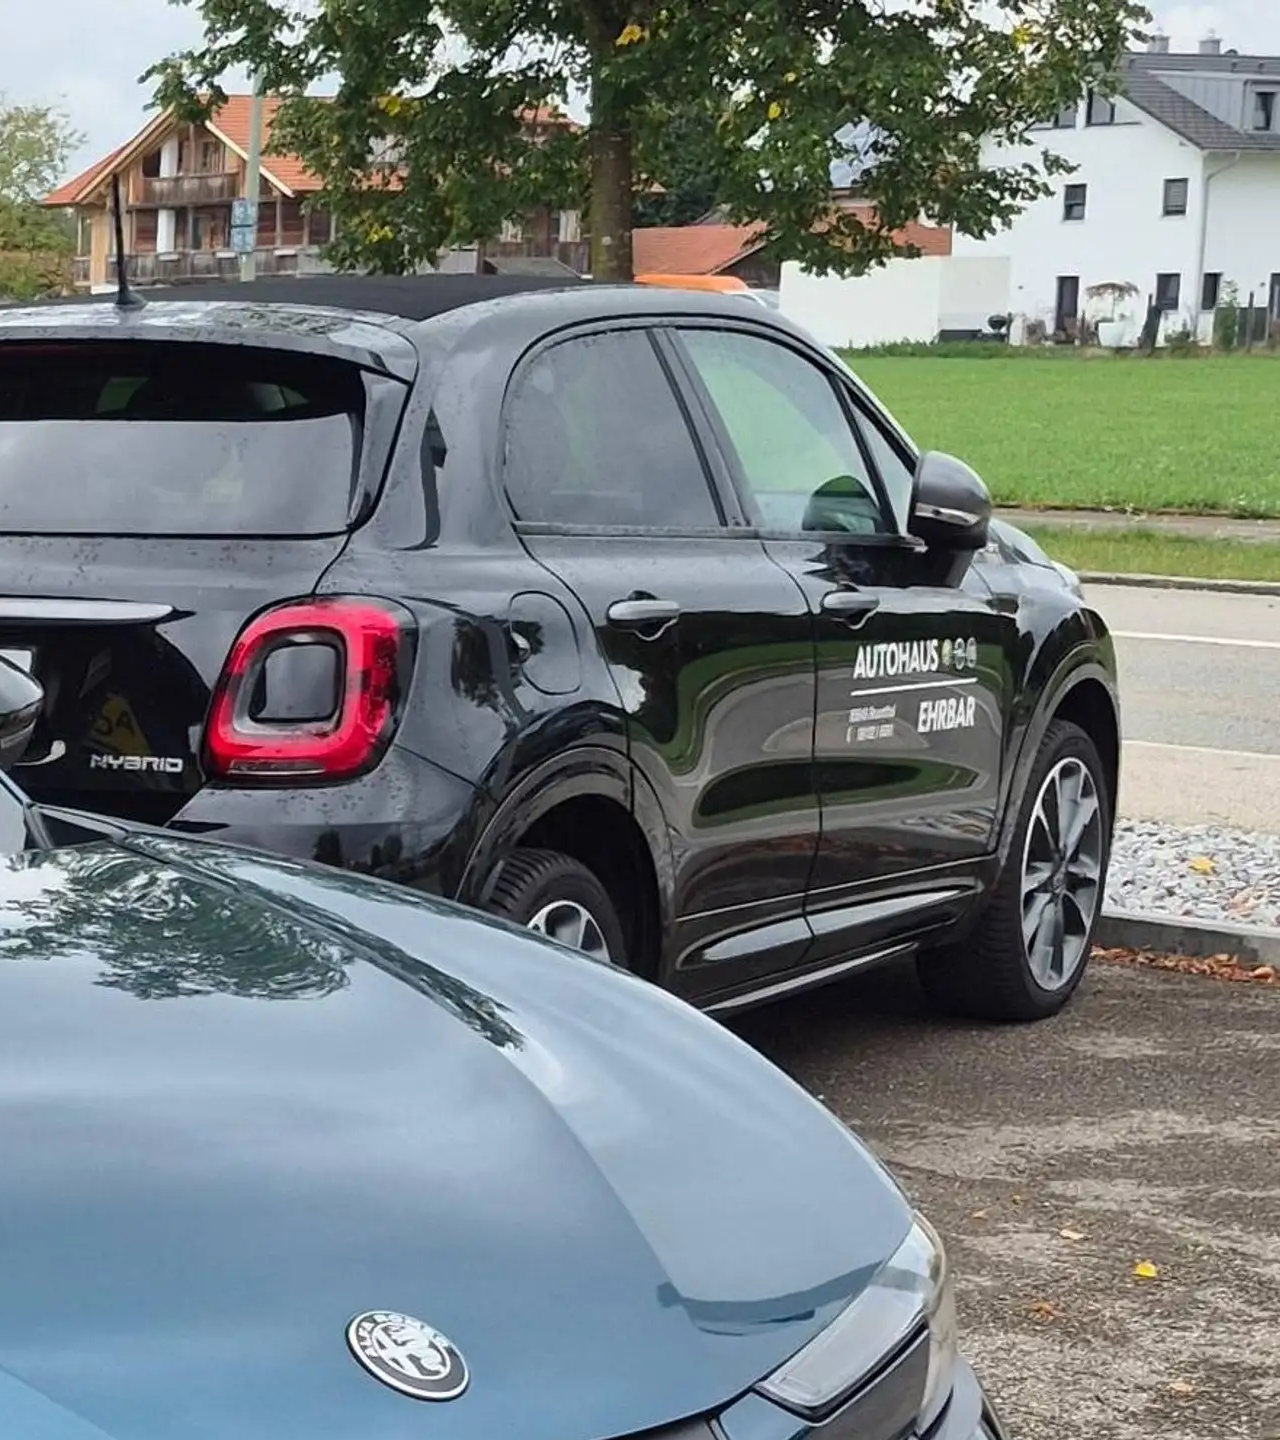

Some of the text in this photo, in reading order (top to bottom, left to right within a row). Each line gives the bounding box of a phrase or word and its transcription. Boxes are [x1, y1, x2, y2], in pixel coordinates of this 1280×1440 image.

[853, 638, 939, 679] AUTOHAUS
[917, 696, 976, 733] EHRBAR
[89, 754, 184, 773] HYBRID
